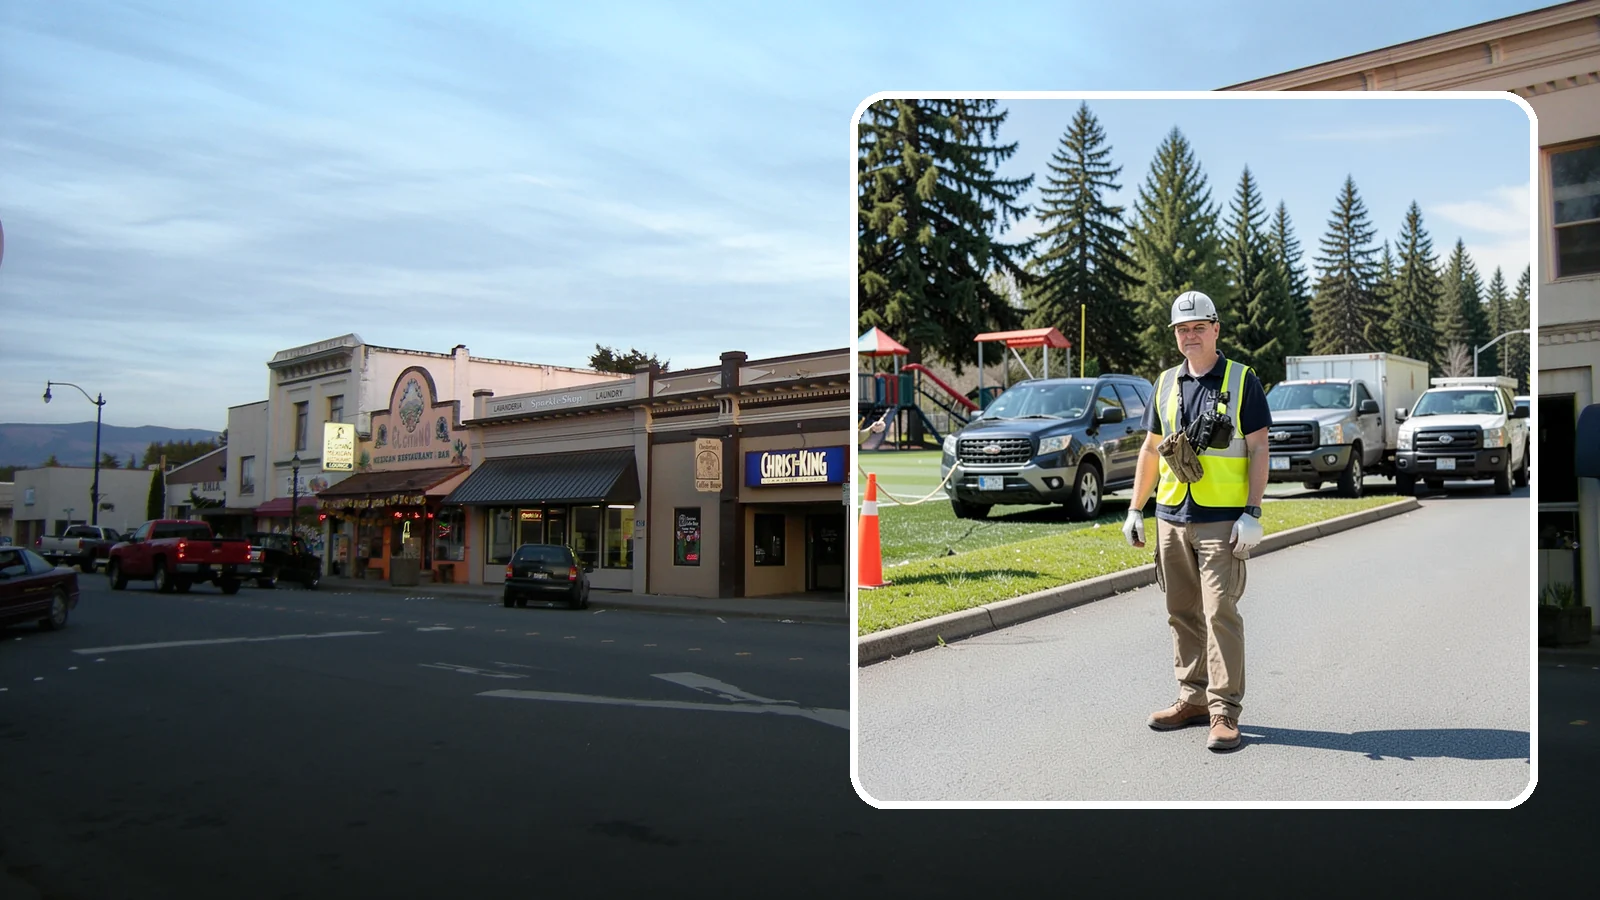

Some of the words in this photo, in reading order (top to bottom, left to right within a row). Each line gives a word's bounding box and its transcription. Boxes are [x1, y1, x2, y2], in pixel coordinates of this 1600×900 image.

[562, 394, 582, 405] Shop
[595, 389, 623, 399] LAUNDRY
[493, 402, 522, 412] LAVANDERIA
[373, 455, 396, 464] MEXICAN
[397, 451, 433, 462] RESTAURANT
[437, 450, 450, 459] BAR
[761, 452, 797, 477] CHRIST
[799, 450, 827, 475] KING
